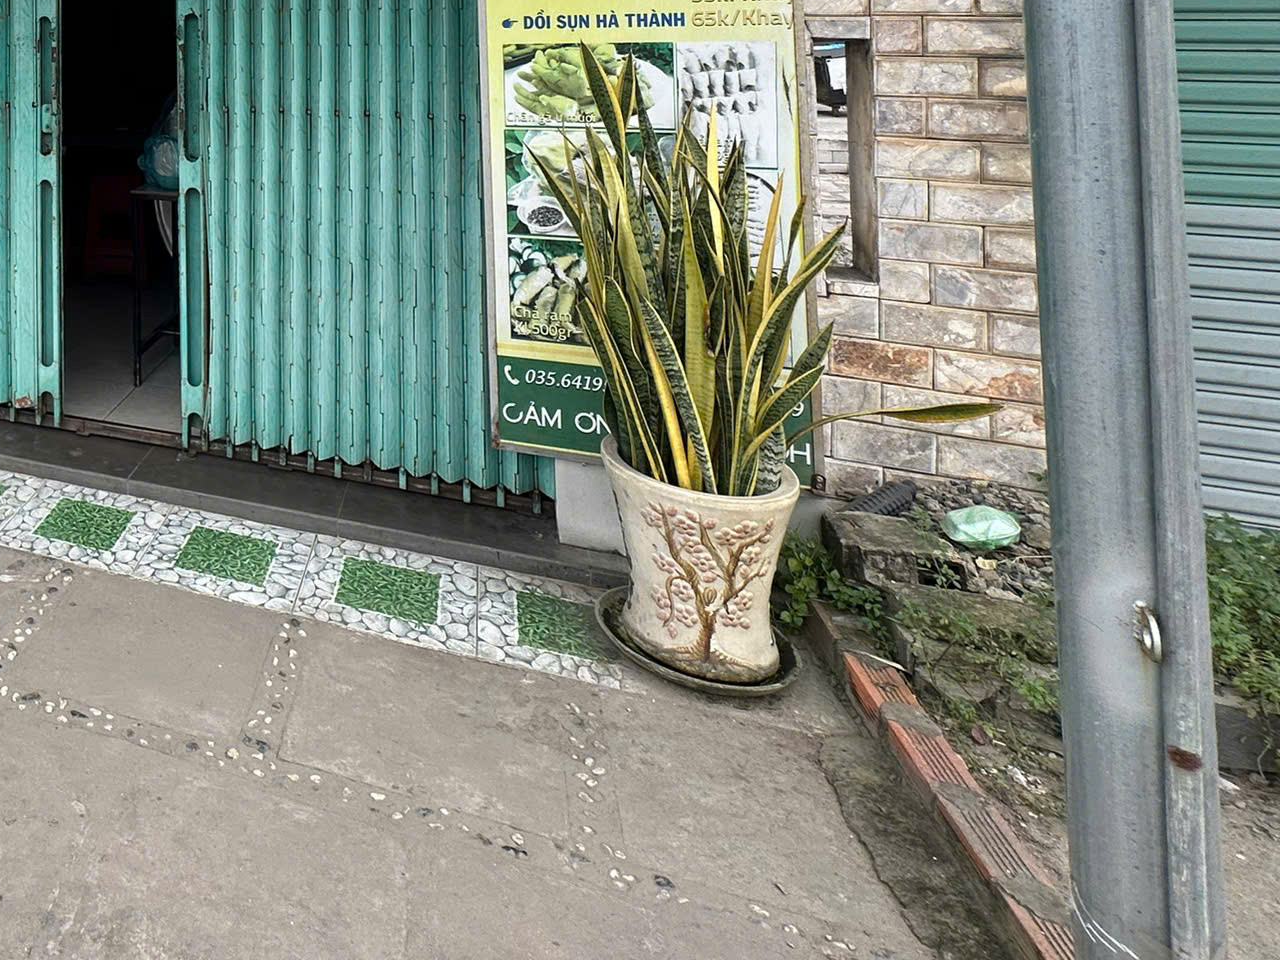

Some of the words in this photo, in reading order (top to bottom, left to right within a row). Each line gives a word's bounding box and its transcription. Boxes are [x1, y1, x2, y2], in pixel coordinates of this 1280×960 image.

[523, 9, 551, 30] DỒI
[556, 14, 590, 33] SỤN
[595, 10, 620, 28] HÀ
[624, 9, 686, 28] THÀNH
[525, 368, 607, 392] 035.6419
[502, 401, 562, 429] CẢM
